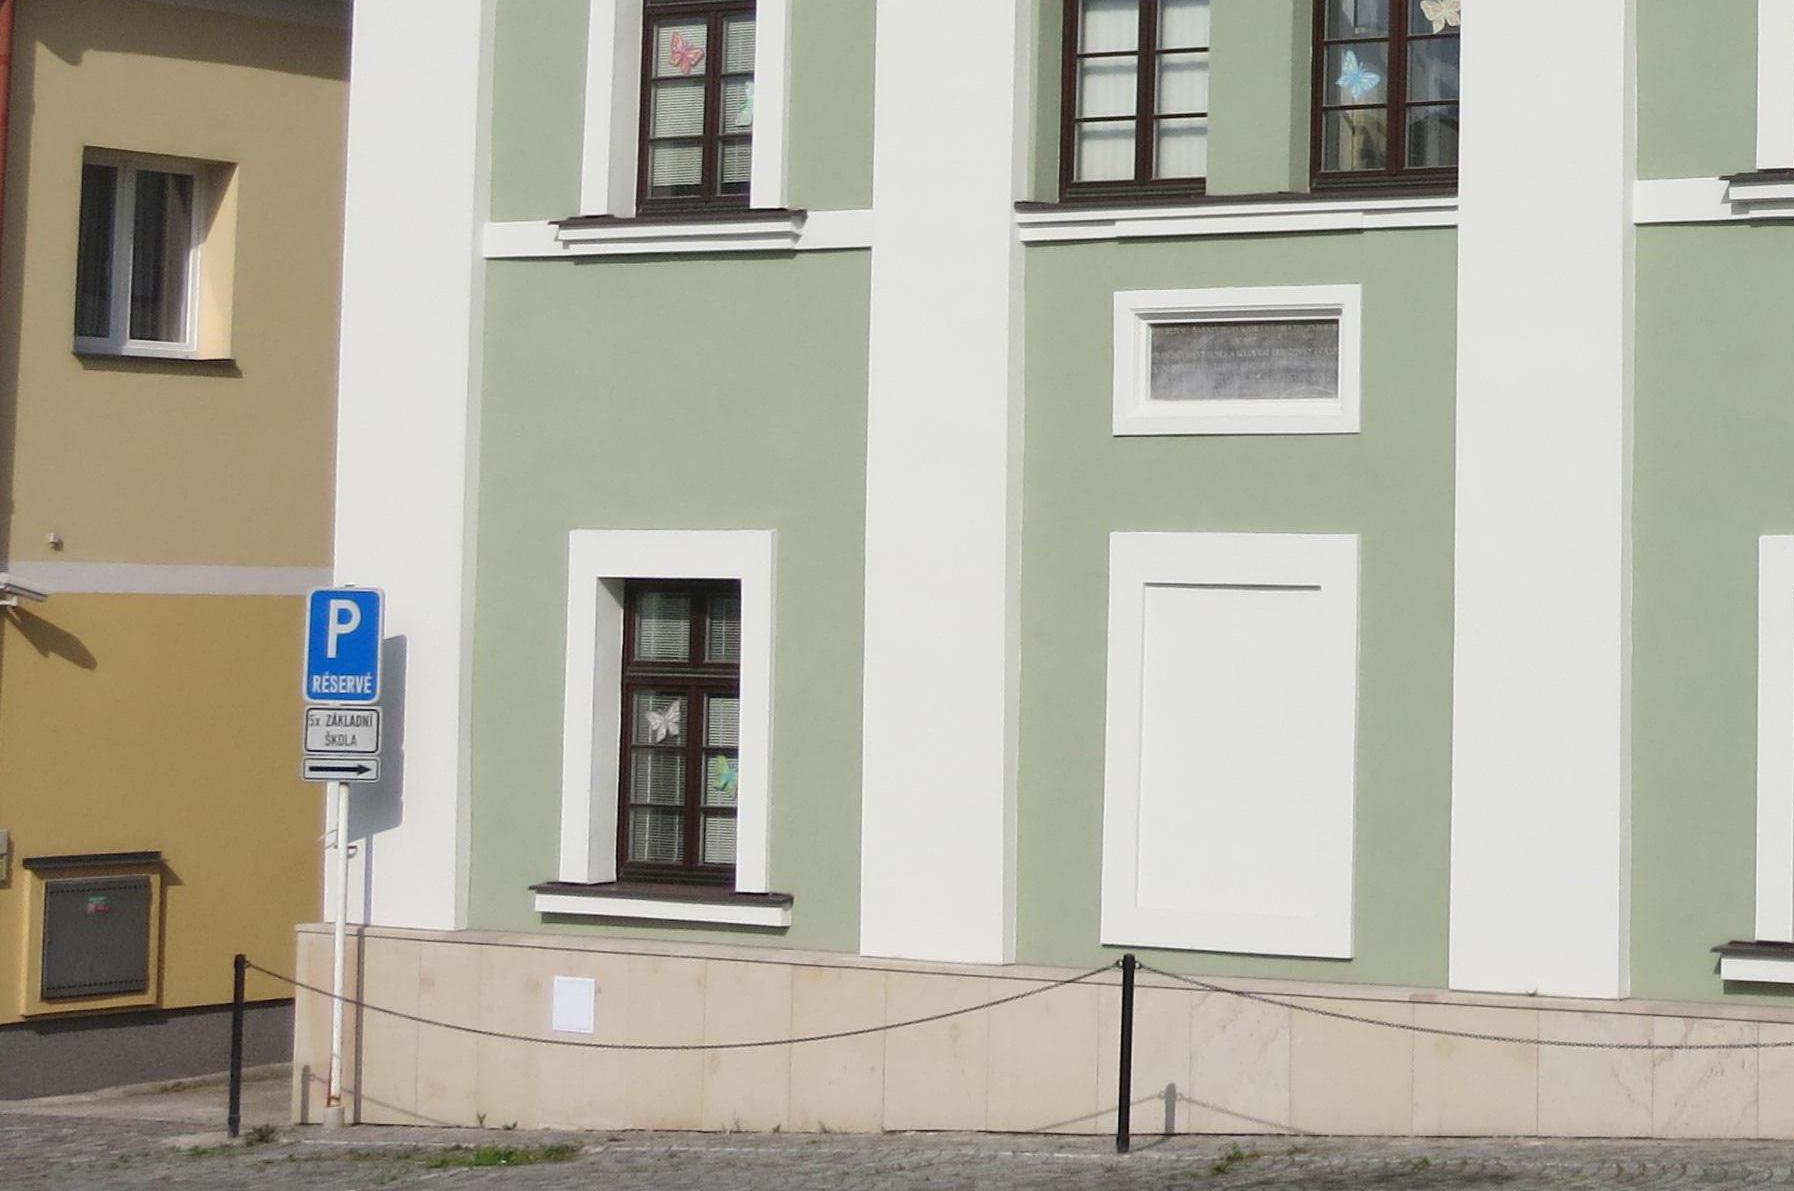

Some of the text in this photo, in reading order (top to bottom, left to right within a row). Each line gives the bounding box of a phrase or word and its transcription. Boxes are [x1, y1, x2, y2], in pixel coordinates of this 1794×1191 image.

[327, 599, 361, 658] P
[312, 671, 373, 694] RÉSERVÉ
[326, 712, 373, 727] ZÁKLADNÍ
[325, 730, 357, 746] ŠKOLA
